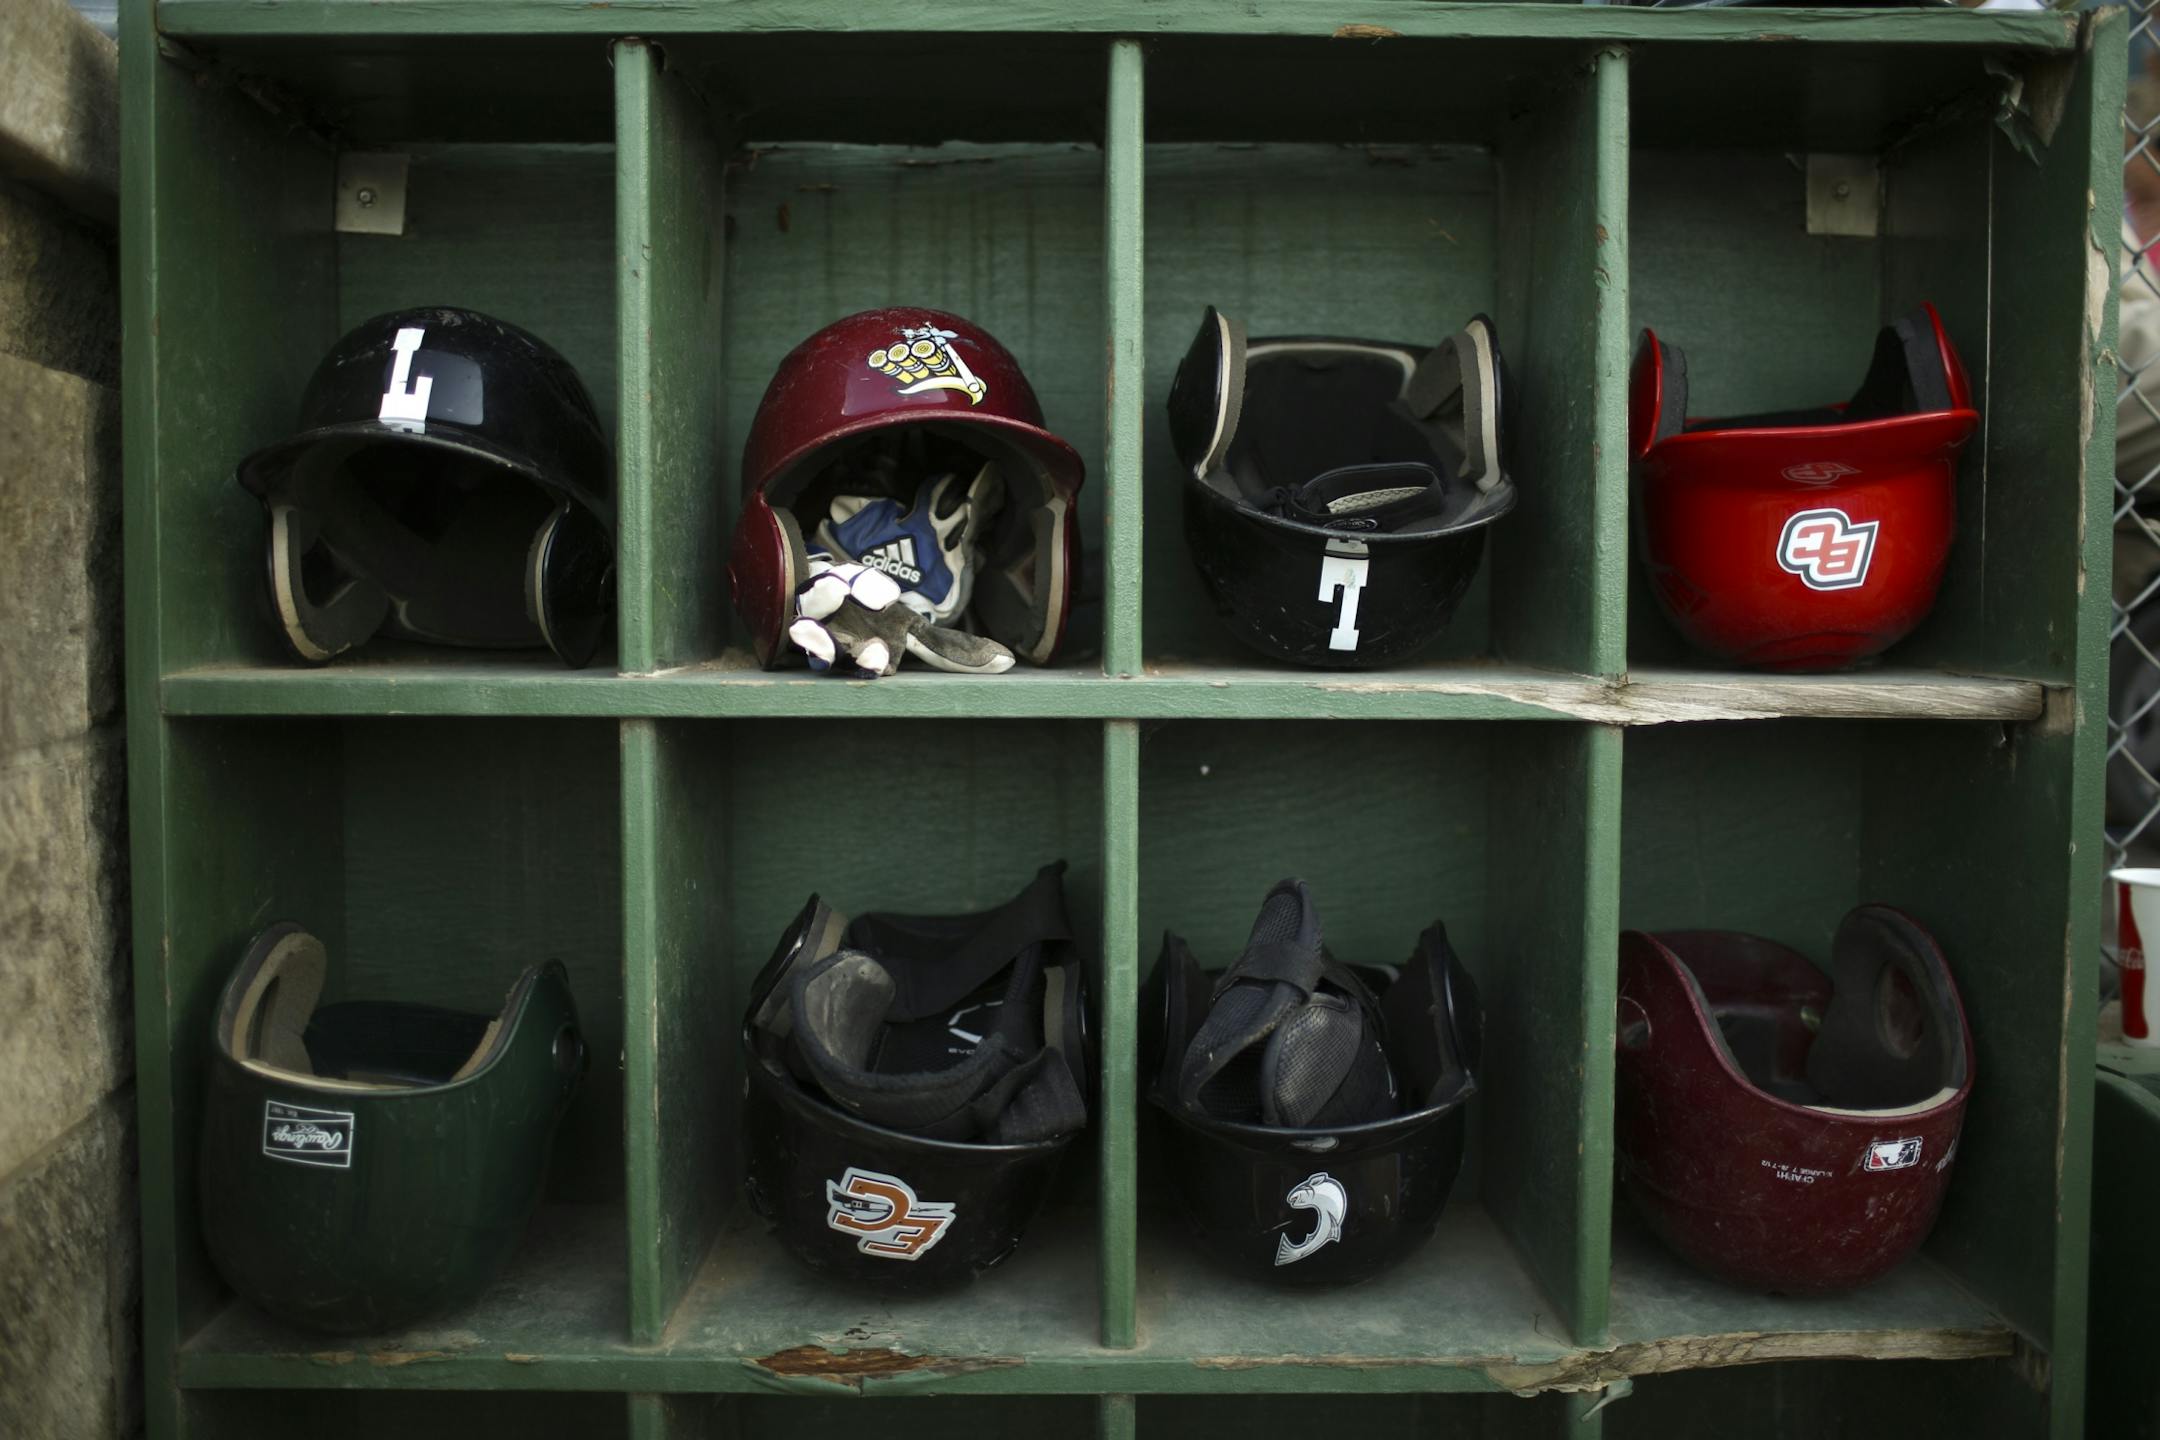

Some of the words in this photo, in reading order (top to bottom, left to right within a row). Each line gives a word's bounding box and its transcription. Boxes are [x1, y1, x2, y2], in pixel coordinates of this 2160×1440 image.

[1785, 516, 1869, 583] BC
[862, 554, 921, 583] adidas
[271, 1124, 343, 1150] Rawlings
